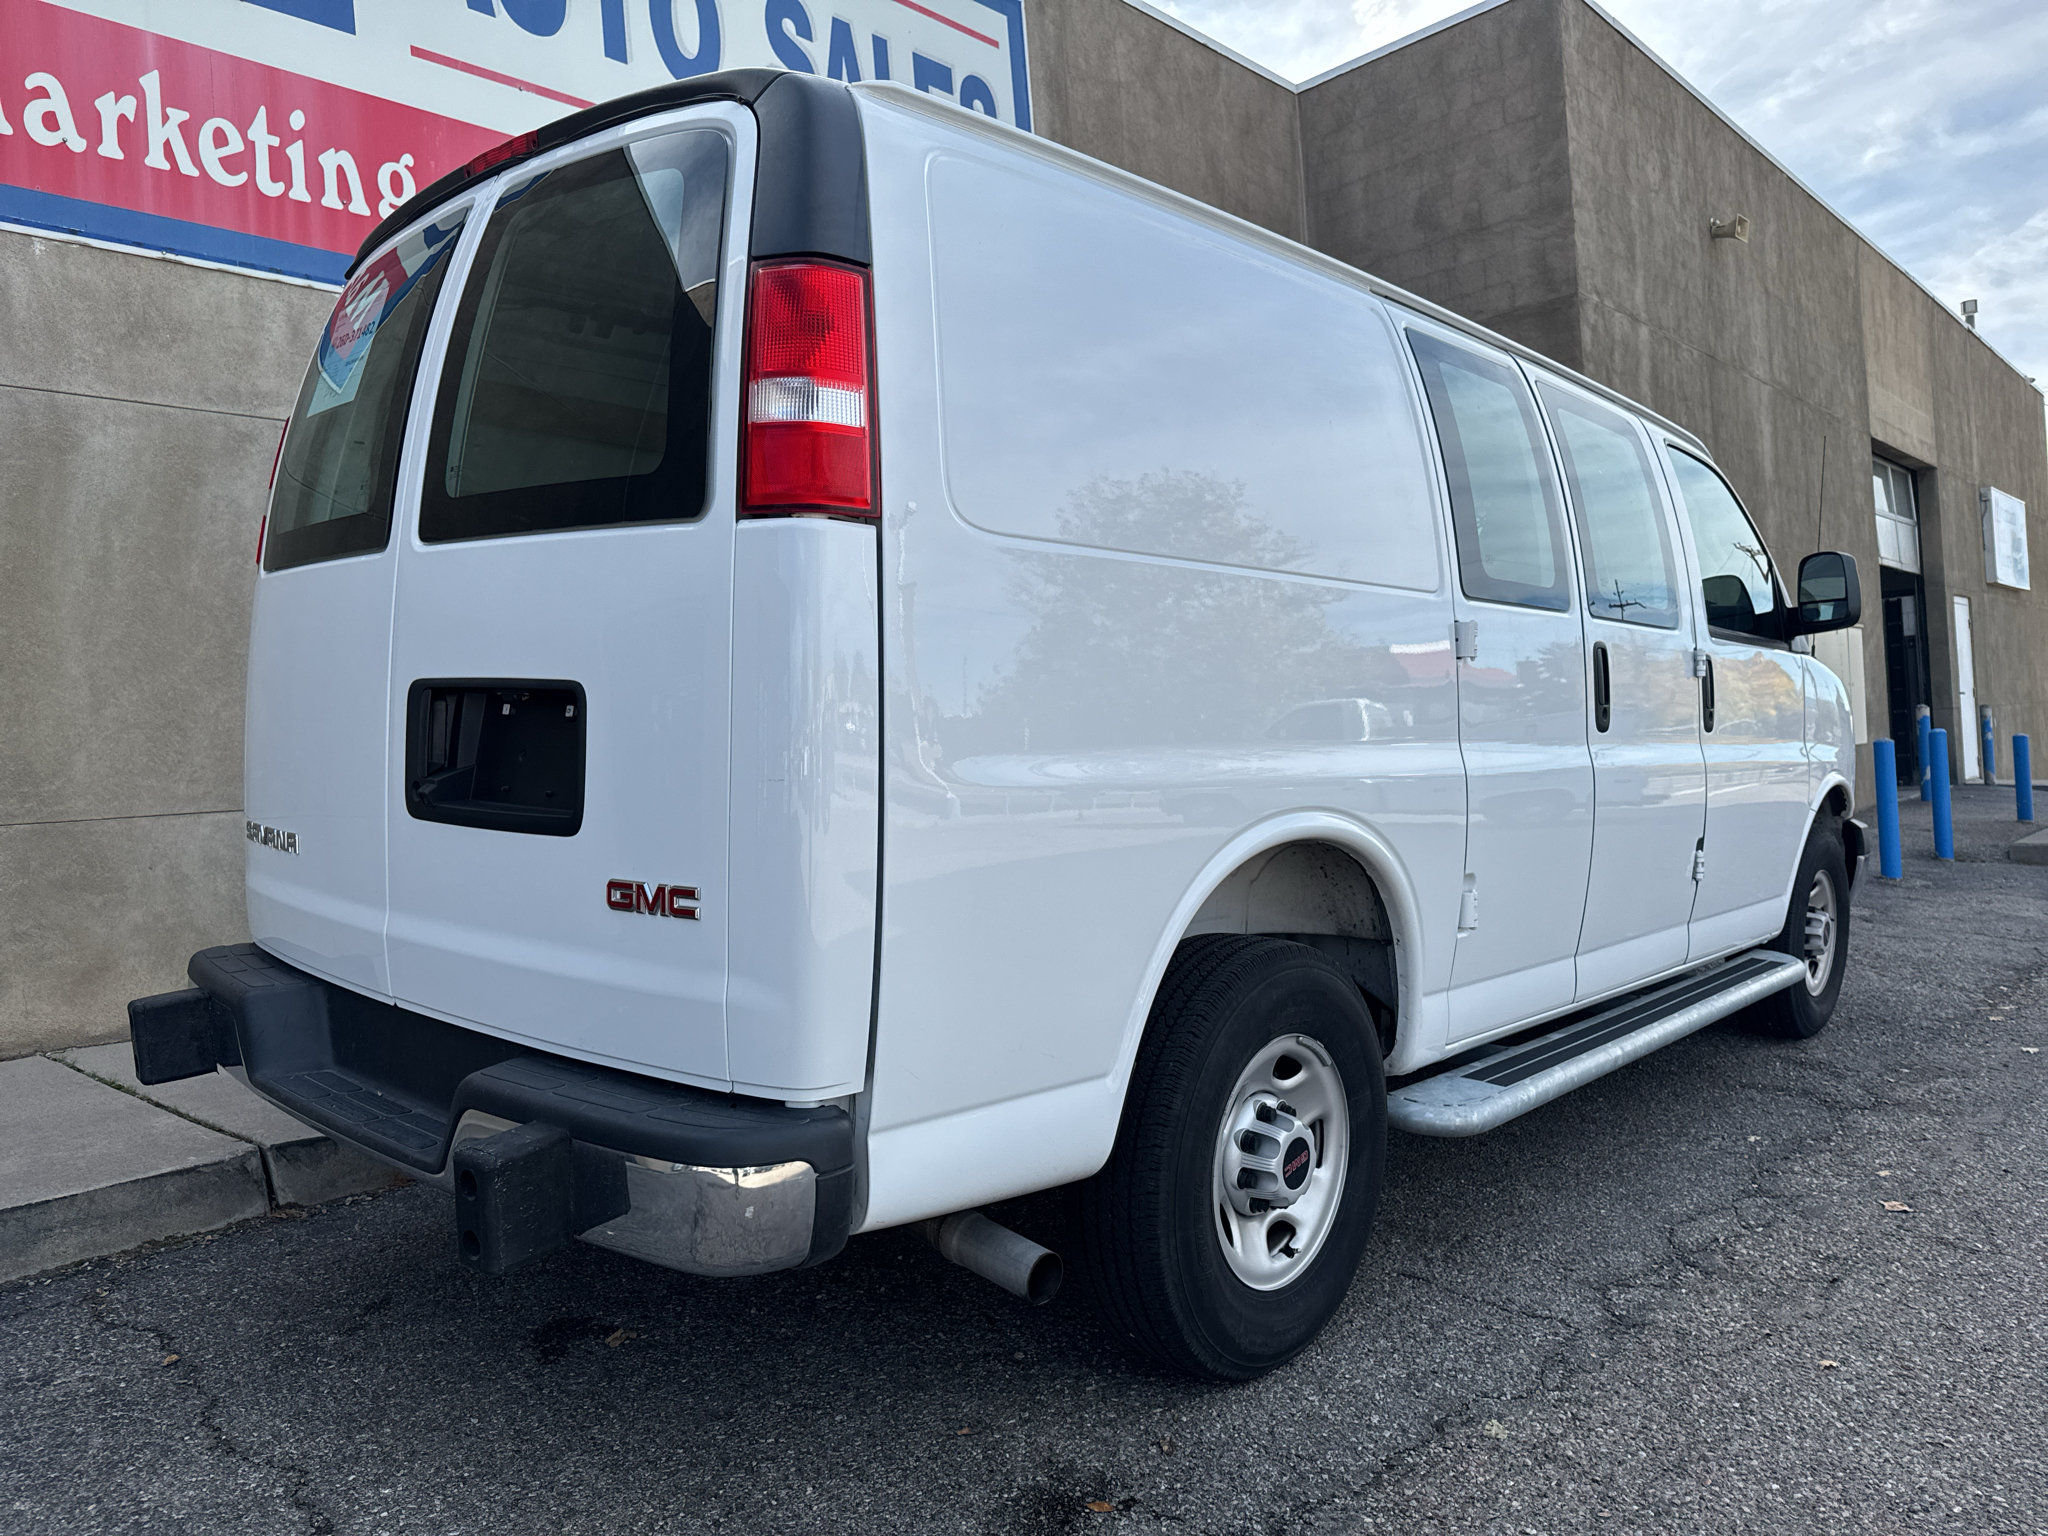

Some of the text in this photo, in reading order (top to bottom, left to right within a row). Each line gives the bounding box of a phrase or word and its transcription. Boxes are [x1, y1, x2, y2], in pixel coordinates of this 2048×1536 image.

[465, 0, 722, 81] TO
[0, 70, 416, 220] arketing
[246, 820, 300, 856] SAVANA
[606, 878, 701, 921] GMC
[1284, 1149, 1309, 1178] GMC
